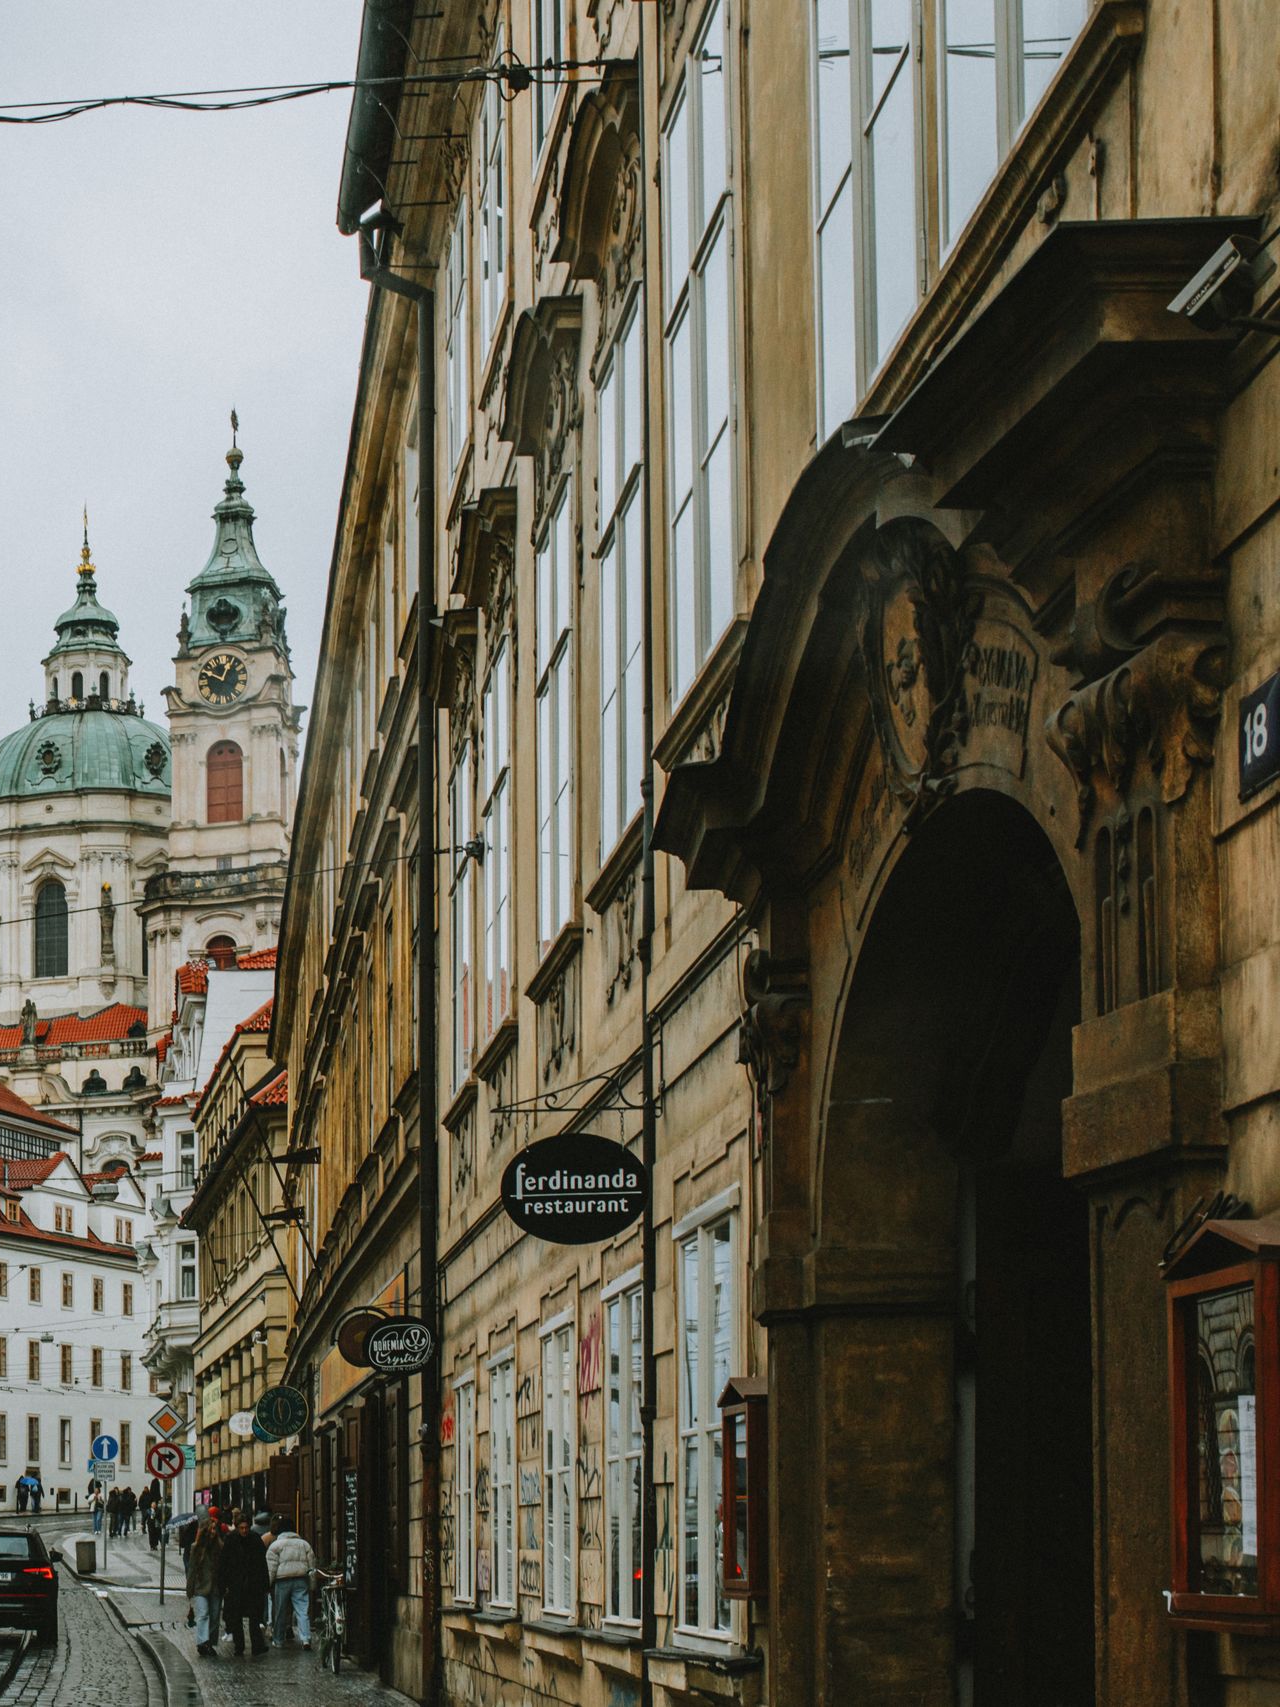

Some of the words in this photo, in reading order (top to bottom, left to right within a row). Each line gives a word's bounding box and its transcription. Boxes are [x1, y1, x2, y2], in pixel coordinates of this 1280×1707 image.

[1244, 703, 1268, 765] 18
[516, 1163, 637, 1199] ferdinanda
[524, 1198, 629, 1215] restaurant
[373, 1340, 405, 1352] BOHEMIA
